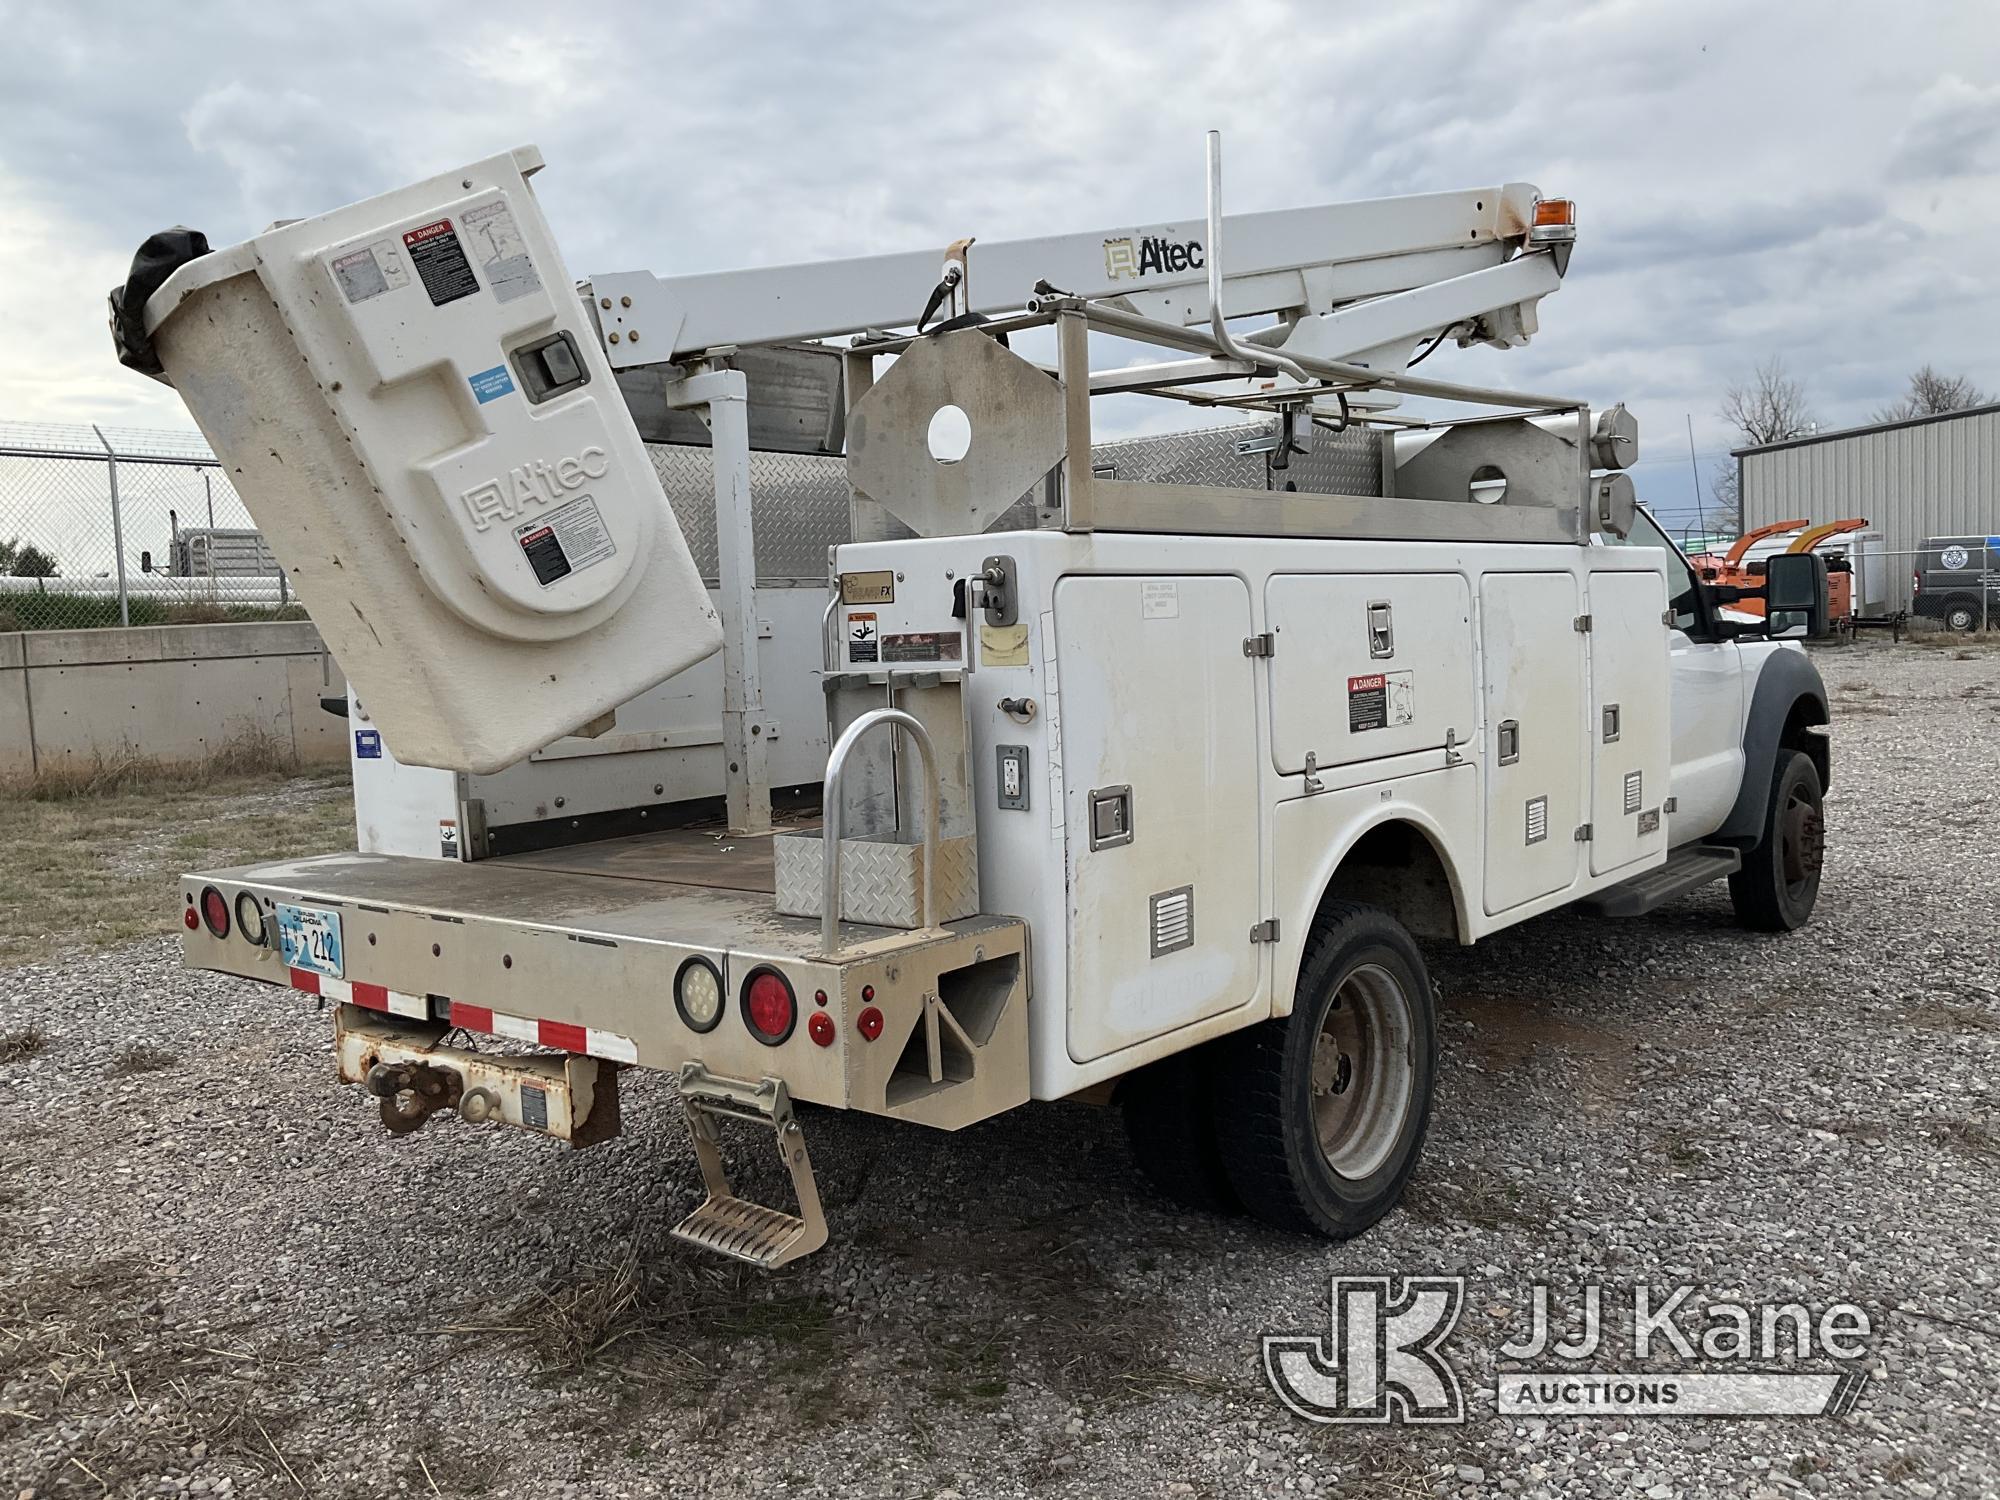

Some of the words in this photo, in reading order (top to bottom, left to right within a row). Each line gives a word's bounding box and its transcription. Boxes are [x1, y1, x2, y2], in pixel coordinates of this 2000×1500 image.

[417, 224, 445, 239] DANGER
[1139, 238, 1204, 276] Altec
[509, 446, 609, 514] Altec
[528, 528, 549, 541] DANGER
[1359, 677, 1382, 689] DANGER
[293, 915, 322, 926] OKLAHOMA
[312, 929, 335, 962] 212
